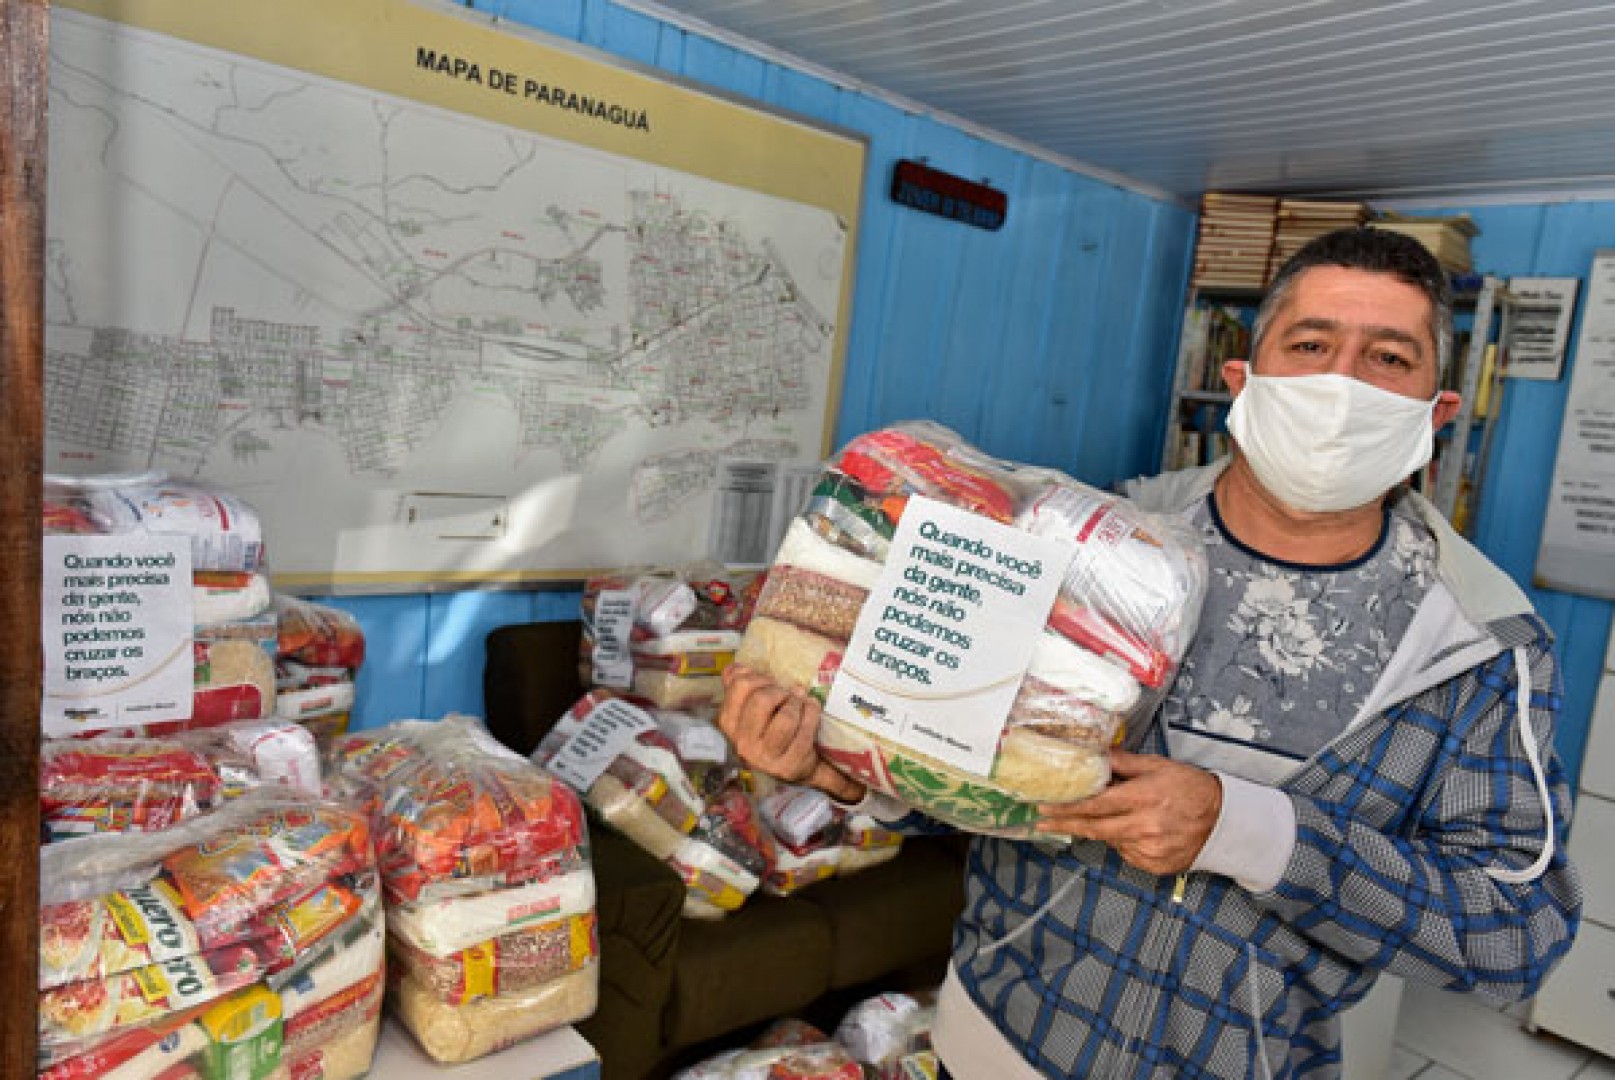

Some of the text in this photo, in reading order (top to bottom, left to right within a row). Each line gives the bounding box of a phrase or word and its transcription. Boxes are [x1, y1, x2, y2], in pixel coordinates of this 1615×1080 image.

[416, 47, 650, 132] MAPA DE PARANAGUÁ
[64, 551, 175, 569] Quando você
[919, 520, 1042, 579] Quando você
[64, 572, 170, 590] mais precisa
[904, 565, 983, 607] da gente,
[909, 546, 1026, 595] mais precisa
[62, 590, 141, 608] da gente,
[62, 608, 132, 625] nós não
[893, 586, 966, 622] nós não
[63, 628, 146, 647] podemos
[881, 605, 971, 650] podemos
[64, 646, 144, 661] cruzar os
[866, 642, 932, 685] braços.
[873, 627, 961, 671] cruzar os
[65, 665, 130, 681] braços.
[125, 882, 184, 949] uero
